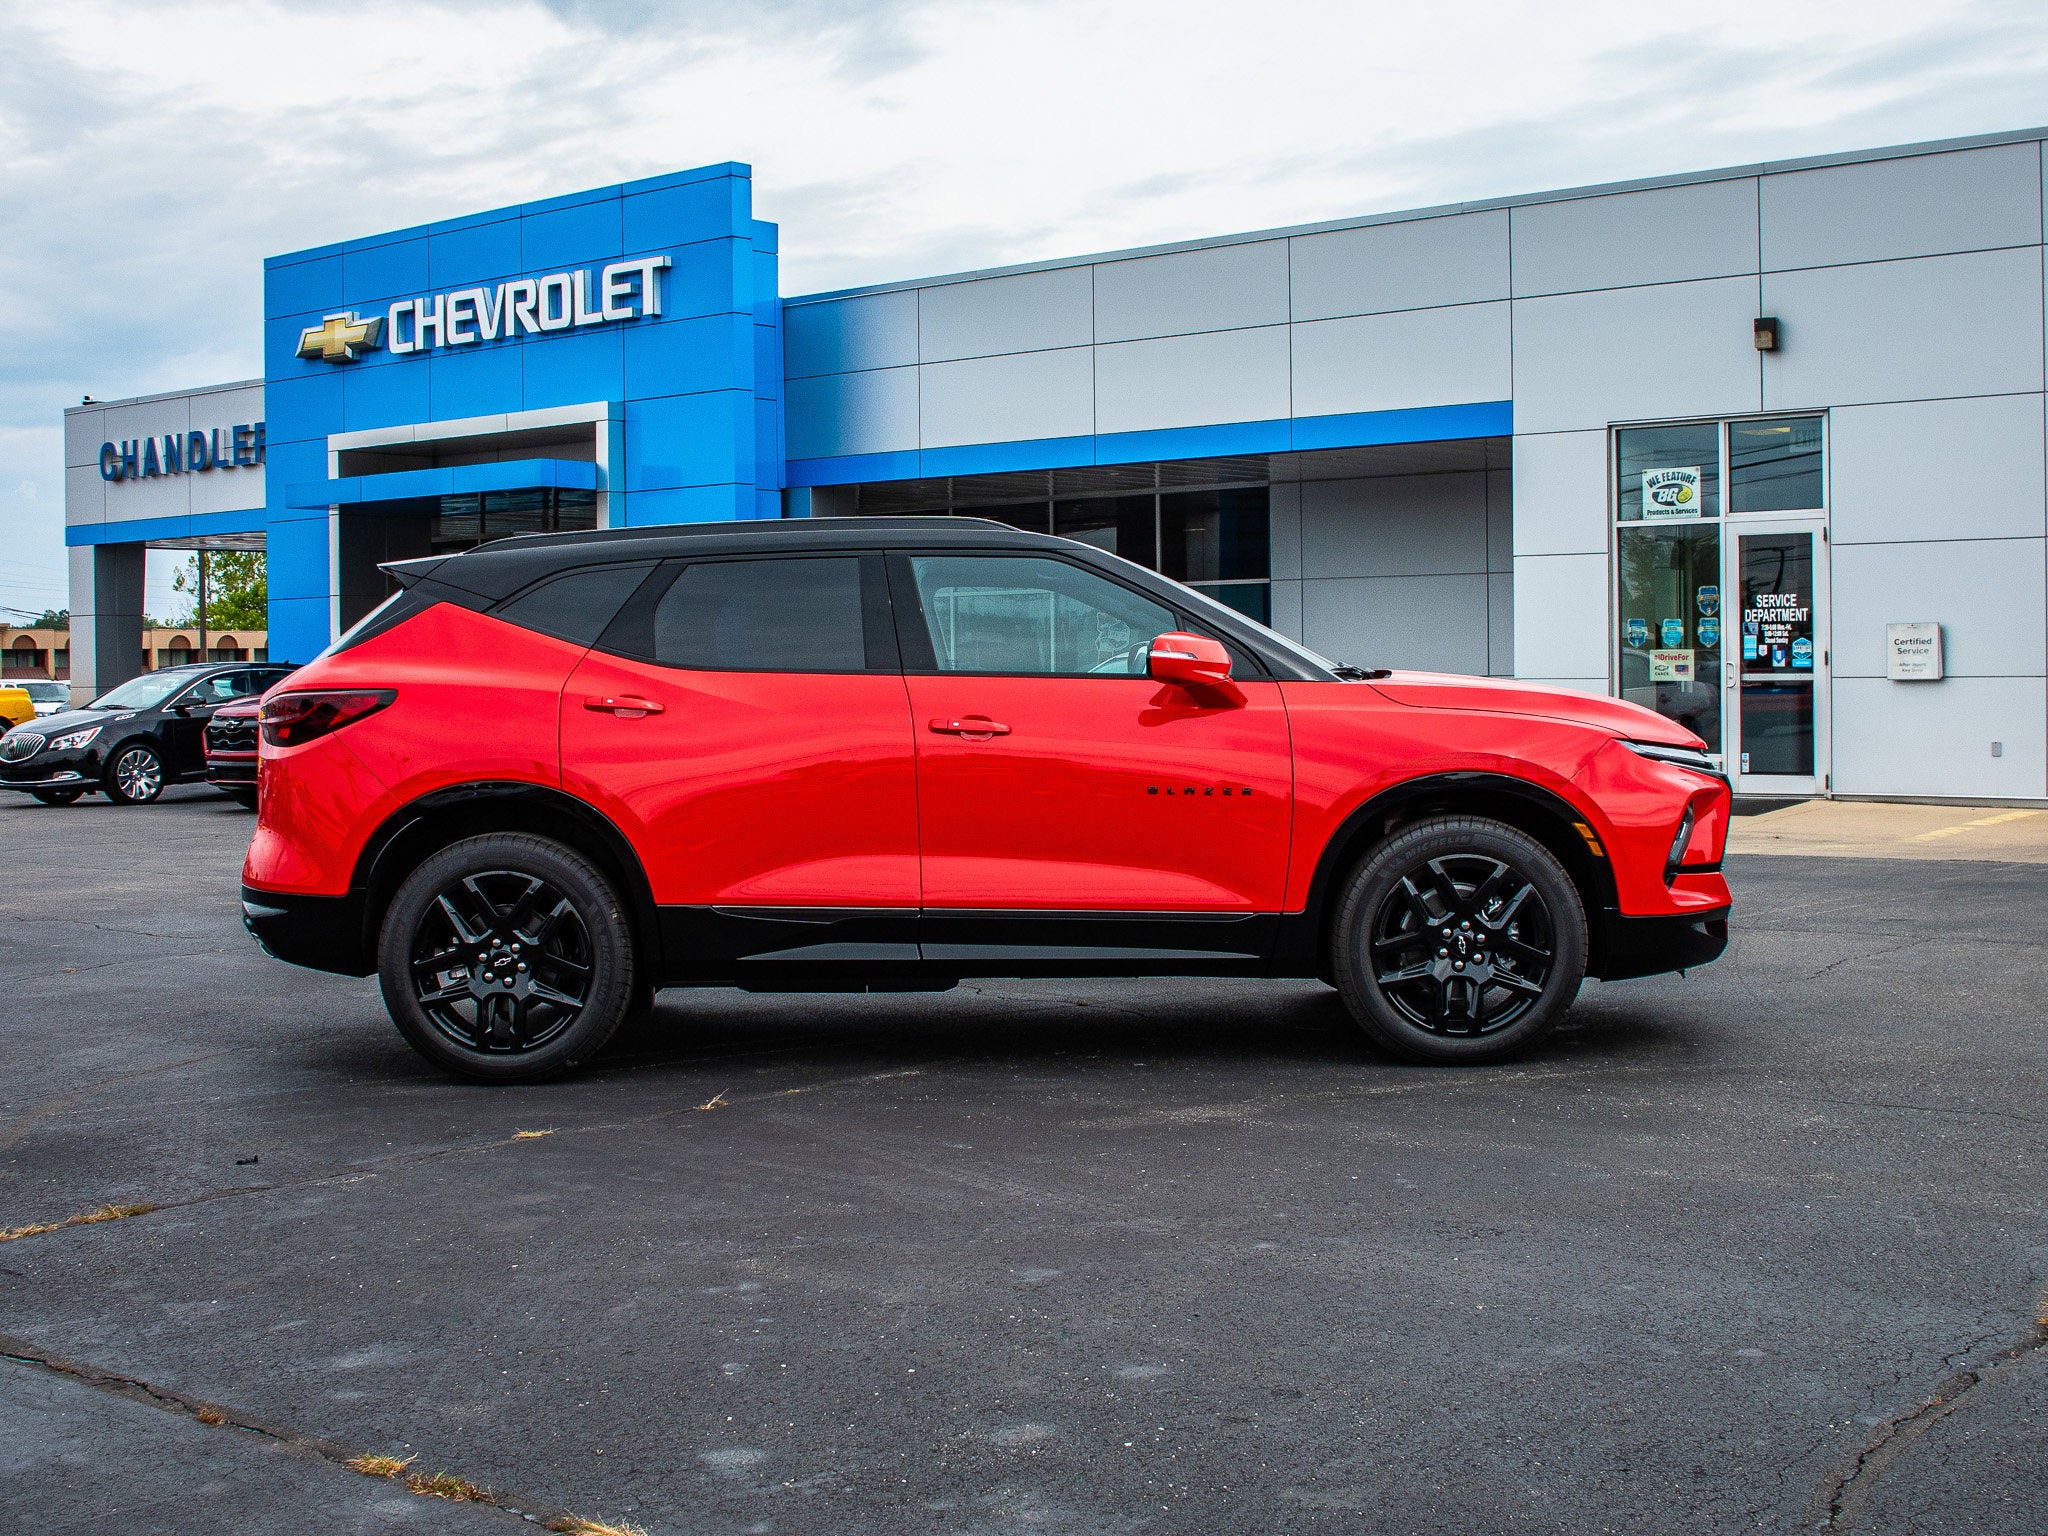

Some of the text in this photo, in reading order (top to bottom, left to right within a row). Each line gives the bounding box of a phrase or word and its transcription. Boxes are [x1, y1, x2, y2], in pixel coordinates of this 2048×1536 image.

[388, 255, 671, 354] CHEVROLET
[1646, 471, 1697, 488] WE FEATURE
[1657, 488, 1679, 502] BG
[1756, 594, 1797, 607] SERVICE
[1744, 608, 1808, 622] DEPARTMENT
[1897, 646, 1929, 654] Service
[1147, 785, 1253, 797] BLAZER
[1405, 834, 1471, 860] MICHELIN
